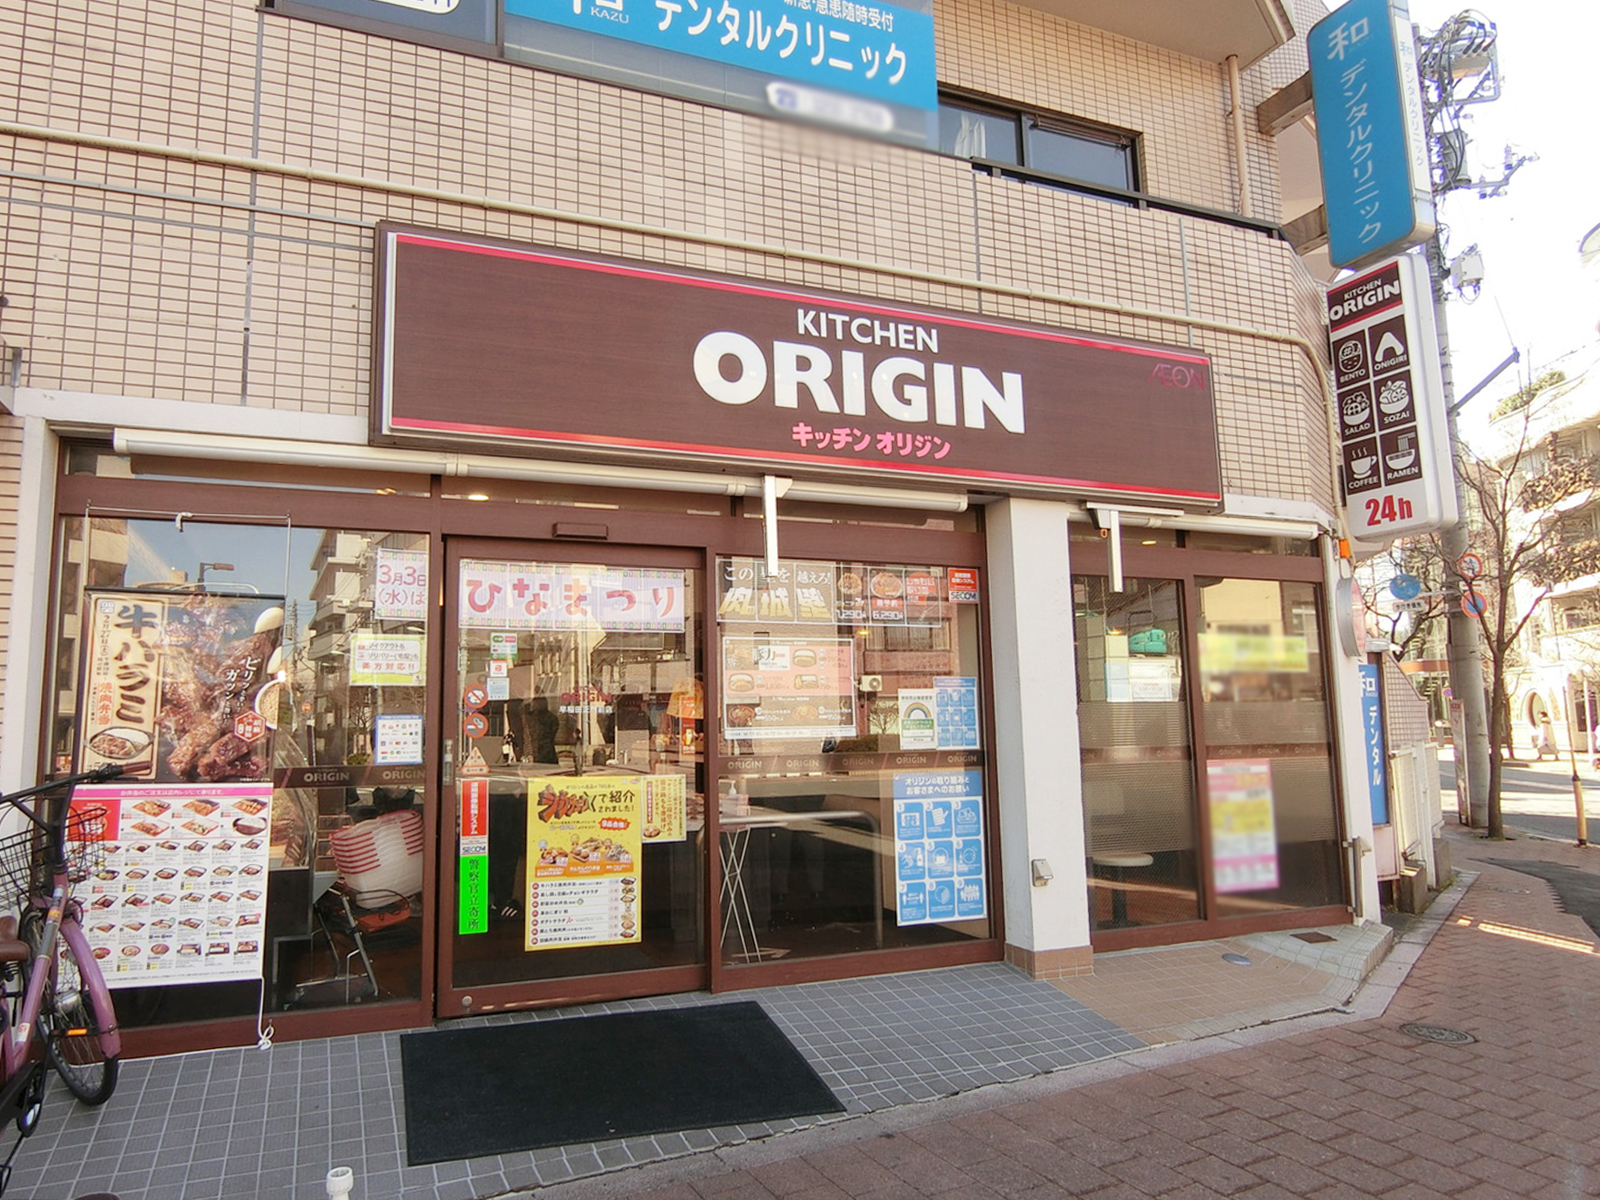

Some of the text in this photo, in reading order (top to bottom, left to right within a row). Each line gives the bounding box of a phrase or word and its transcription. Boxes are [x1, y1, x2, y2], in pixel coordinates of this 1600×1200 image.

[593, 6, 629, 23] KAZU
[655, 0, 908, 85] デンタルクリニック
[1327, 17, 1369, 61] 和
[1340, 58, 1382, 244] デンタルクリニック
[1344, 278, 1382, 300] KITCHEN
[1329, 280, 1401, 322] ORIGIN
[797, 308, 938, 354] KITCHEN
[1374, 354, 1408, 371] ONIGIRI
[692, 331, 1025, 435] ORIGIN
[1340, 368, 1366, 383] BENTO
[1383, 410, 1410, 425] SOZAI
[1344, 422, 1371, 436] SALAD
[791, 421, 952, 461] キッチン オリジン
[1387, 466, 1419, 481] RAMEN
[1348, 476, 1379, 490] COFFEE
[1365, 494, 1413, 527] 24h
[378, 564, 426, 587] 3月3日
[723, 566, 832, 585] このを越えろ!
[378, 588, 426, 606] (水)は
[466, 577, 675, 618] ひなまつり
[950, 592, 977, 600] SECOM
[114, 604, 158, 724] 牛ハラミ
[1369, 706, 1381, 786] デンタル
[727, 760, 762, 769] ORIGIN
[786, 757, 820, 768] ORIGIN
[895, 755, 927, 765] ORIGIN
[947, 755, 977, 763] ORIGIN
[304, 771, 350, 782] ORIGIN
[383, 769, 425, 781] ORIGIN
[905, 775, 969, 786] オリジンの取り組みと
[906, 785, 969, 795] お客さまへのお願い
[462, 846, 486, 854] SECOM
[467, 858, 480, 930] 警察官立寄所
